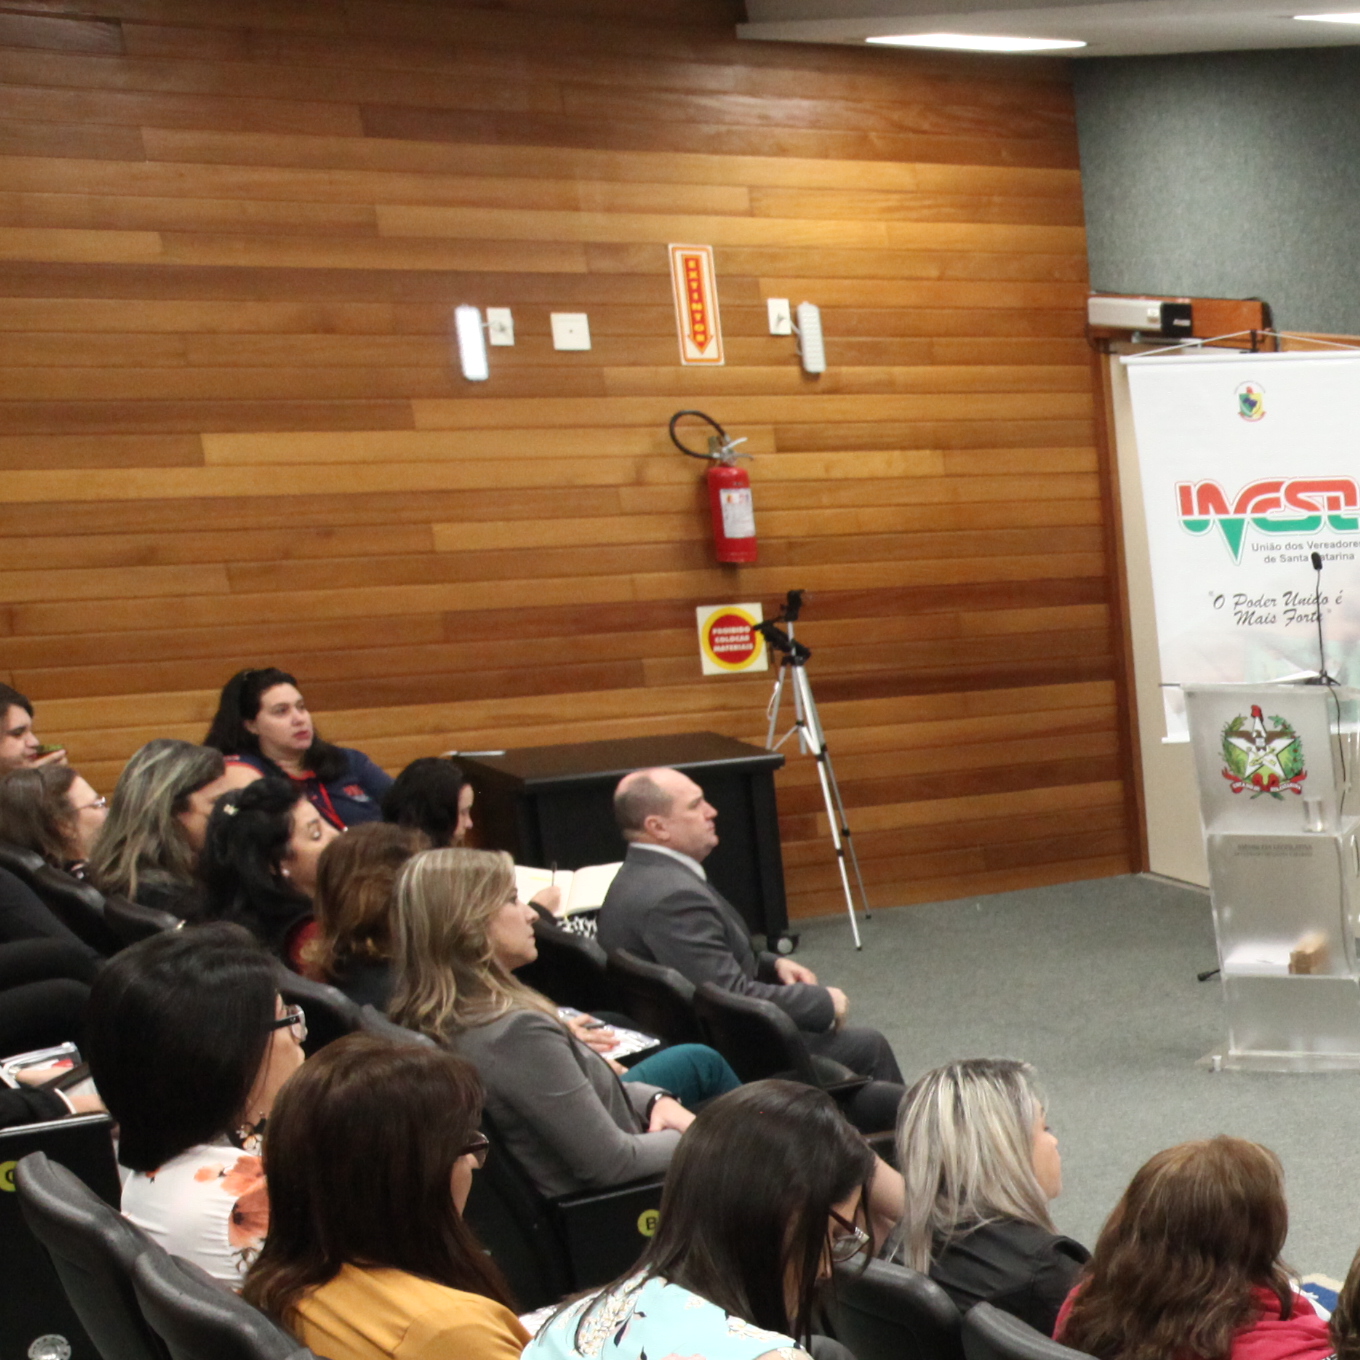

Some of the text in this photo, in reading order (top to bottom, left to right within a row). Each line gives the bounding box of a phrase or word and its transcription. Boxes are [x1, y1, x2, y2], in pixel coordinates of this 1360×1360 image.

[1251, 542, 1282, 552] União
[1284, 541, 1303, 551] dos
[1264, 552, 1355, 563] de Santa atarina
[1232, 593, 1278, 611] Poder
[1282, 591, 1329, 607] Unido
[1334, 590, 1343, 605] é
[1233, 611, 1277, 626] Mais
